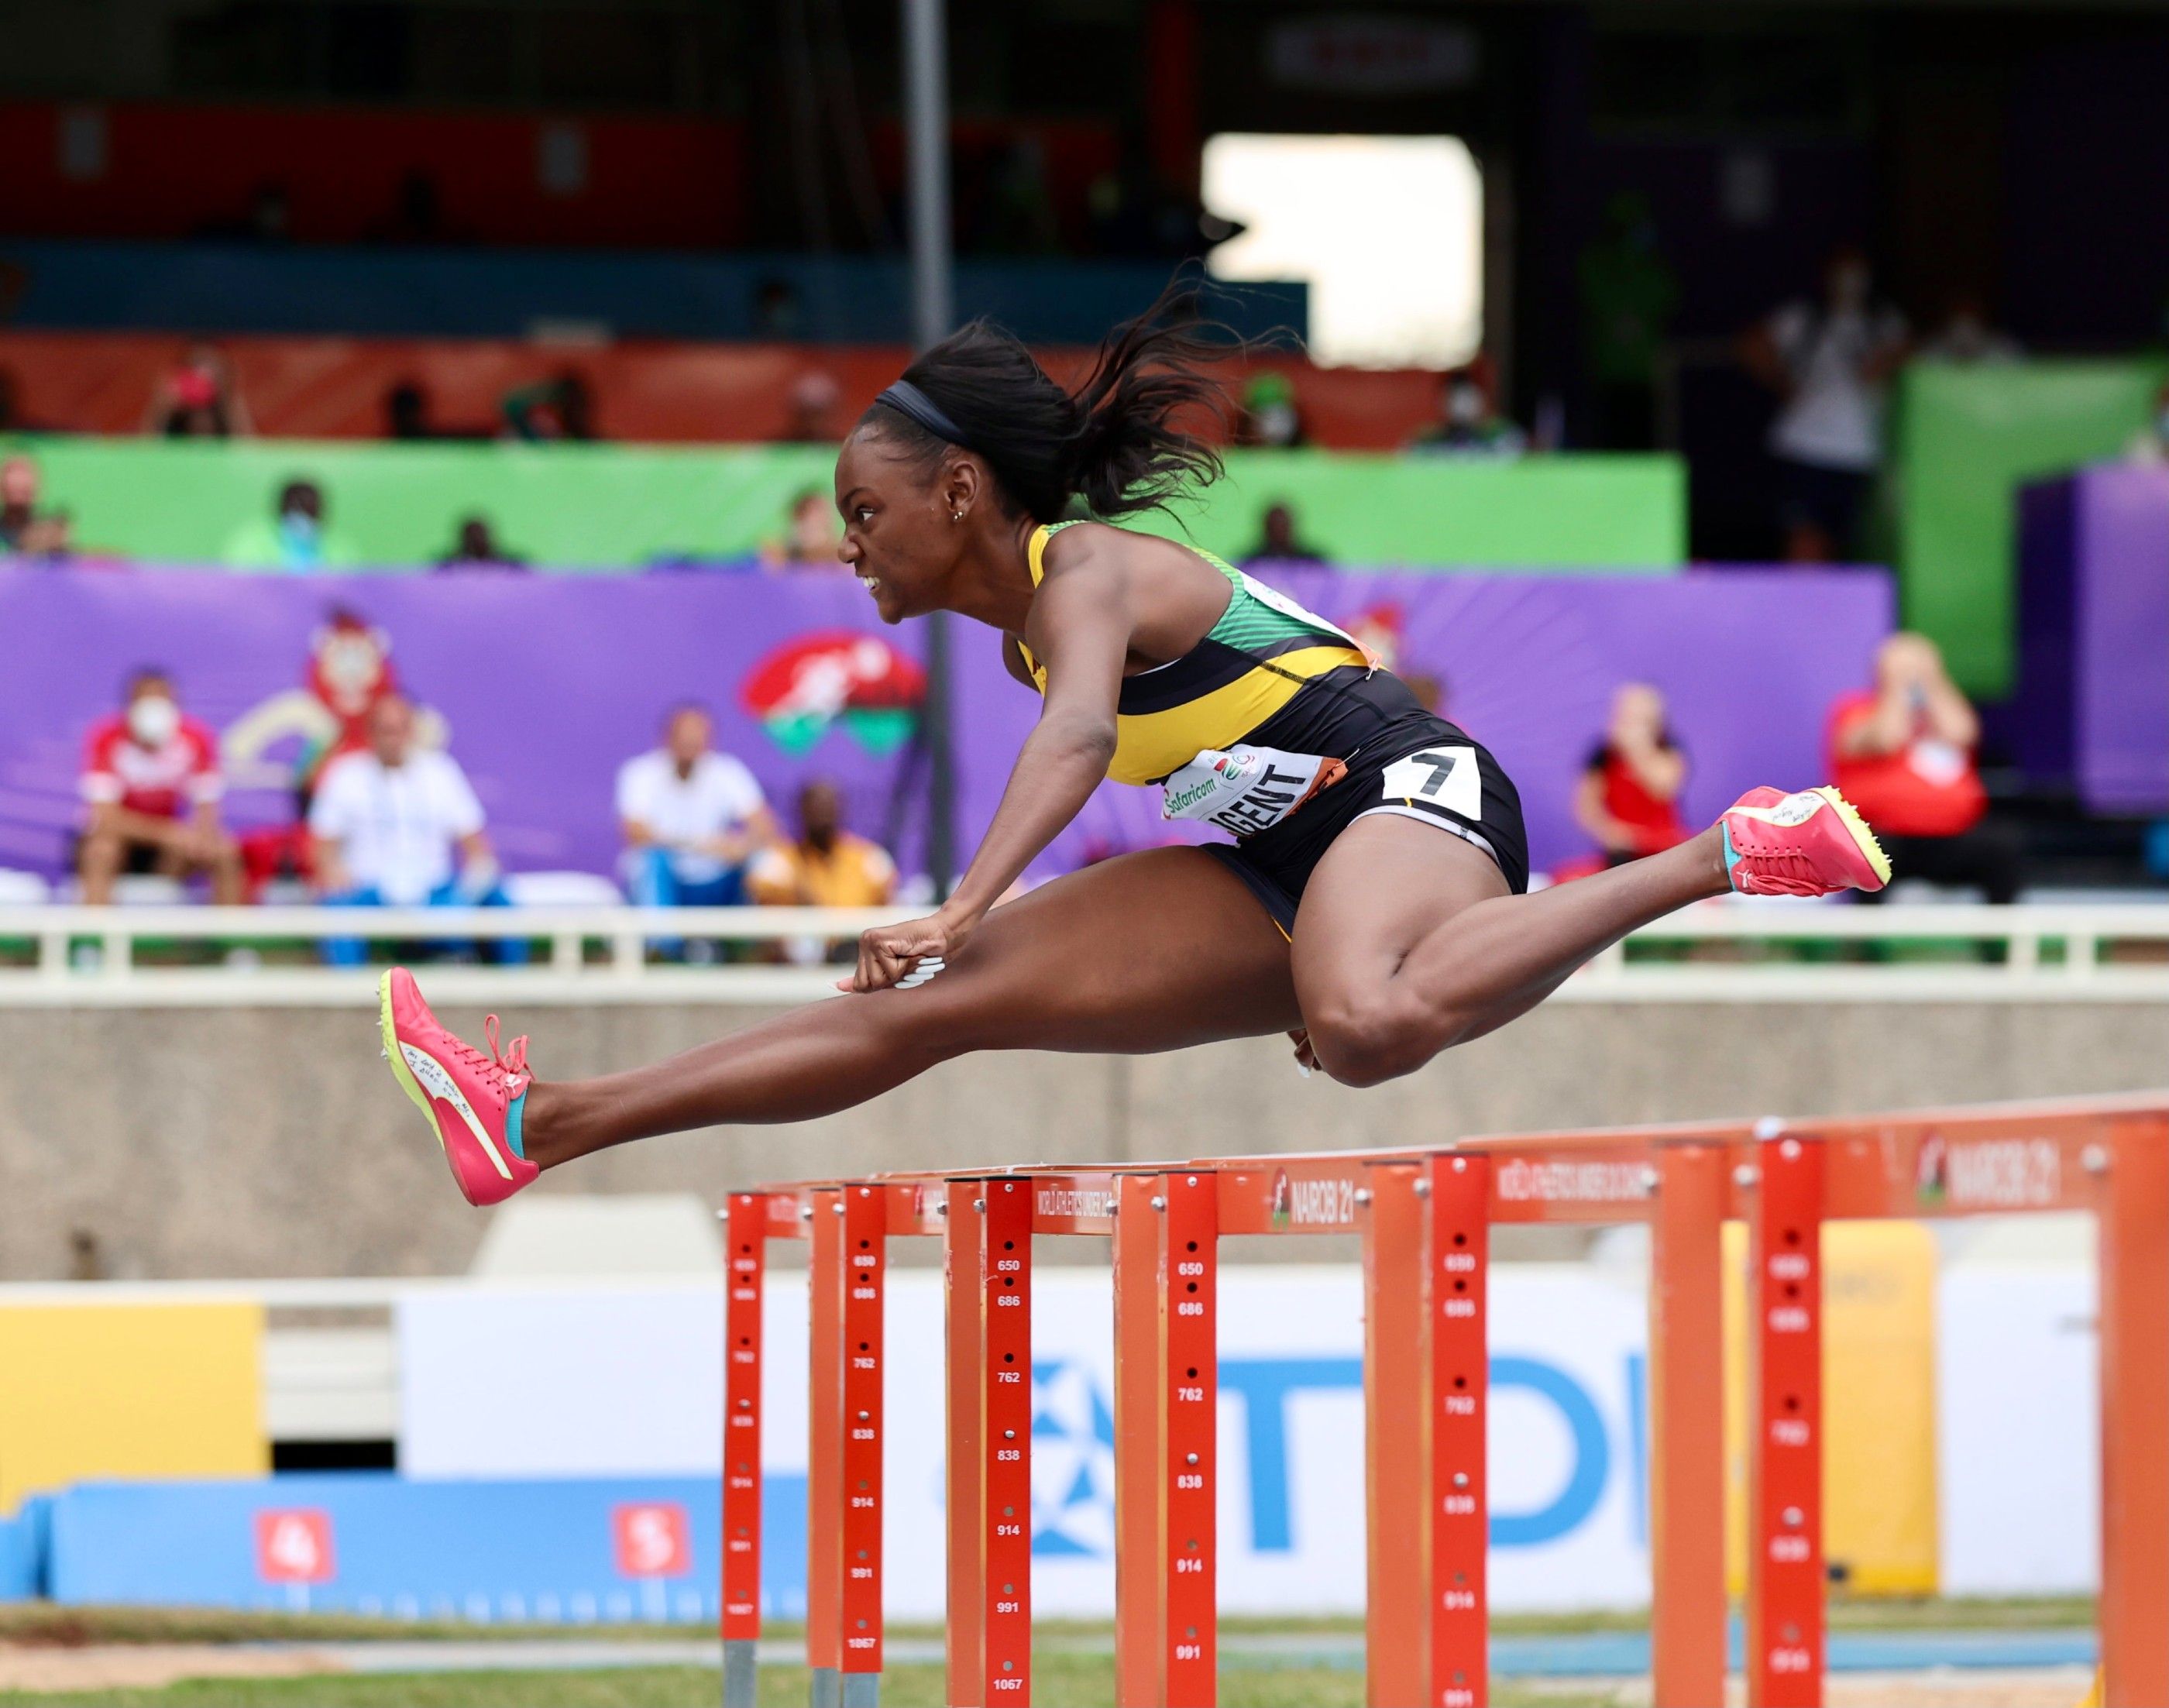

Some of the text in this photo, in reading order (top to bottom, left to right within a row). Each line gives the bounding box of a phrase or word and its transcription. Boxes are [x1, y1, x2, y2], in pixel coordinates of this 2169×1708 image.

[1411, 752, 1456, 796] 7
[1165, 778, 1217, 813] Safaricom
[1291, 1178, 1353, 1224] NAIROBI 21
[998, 1260, 1020, 1271] 650
[1178, 1262, 1204, 1276] 650
[998, 1295, 1020, 1307] 686
[1177, 1302, 1203, 1316] 686
[854, 1357, 875, 1369] 762
[998, 1372, 1020, 1383] 762
[1178, 1387, 1203, 1401] 762
[998, 1449, 1020, 1461] 838
[1177, 1475, 1203, 1489] 838
[851, 1497, 874, 1507] 914
[997, 1524, 1020, 1536] 914
[270, 1516, 317, 1571] 4
[1177, 1559, 1202, 1573] 914
[851, 1568, 872, 1579] 991
[996, 1602, 1019, 1613] 991
[848, 1638, 876, 1648] 1067
[1176, 1645, 1201, 1660] 991
[994, 1679, 1023, 1690] 1067
